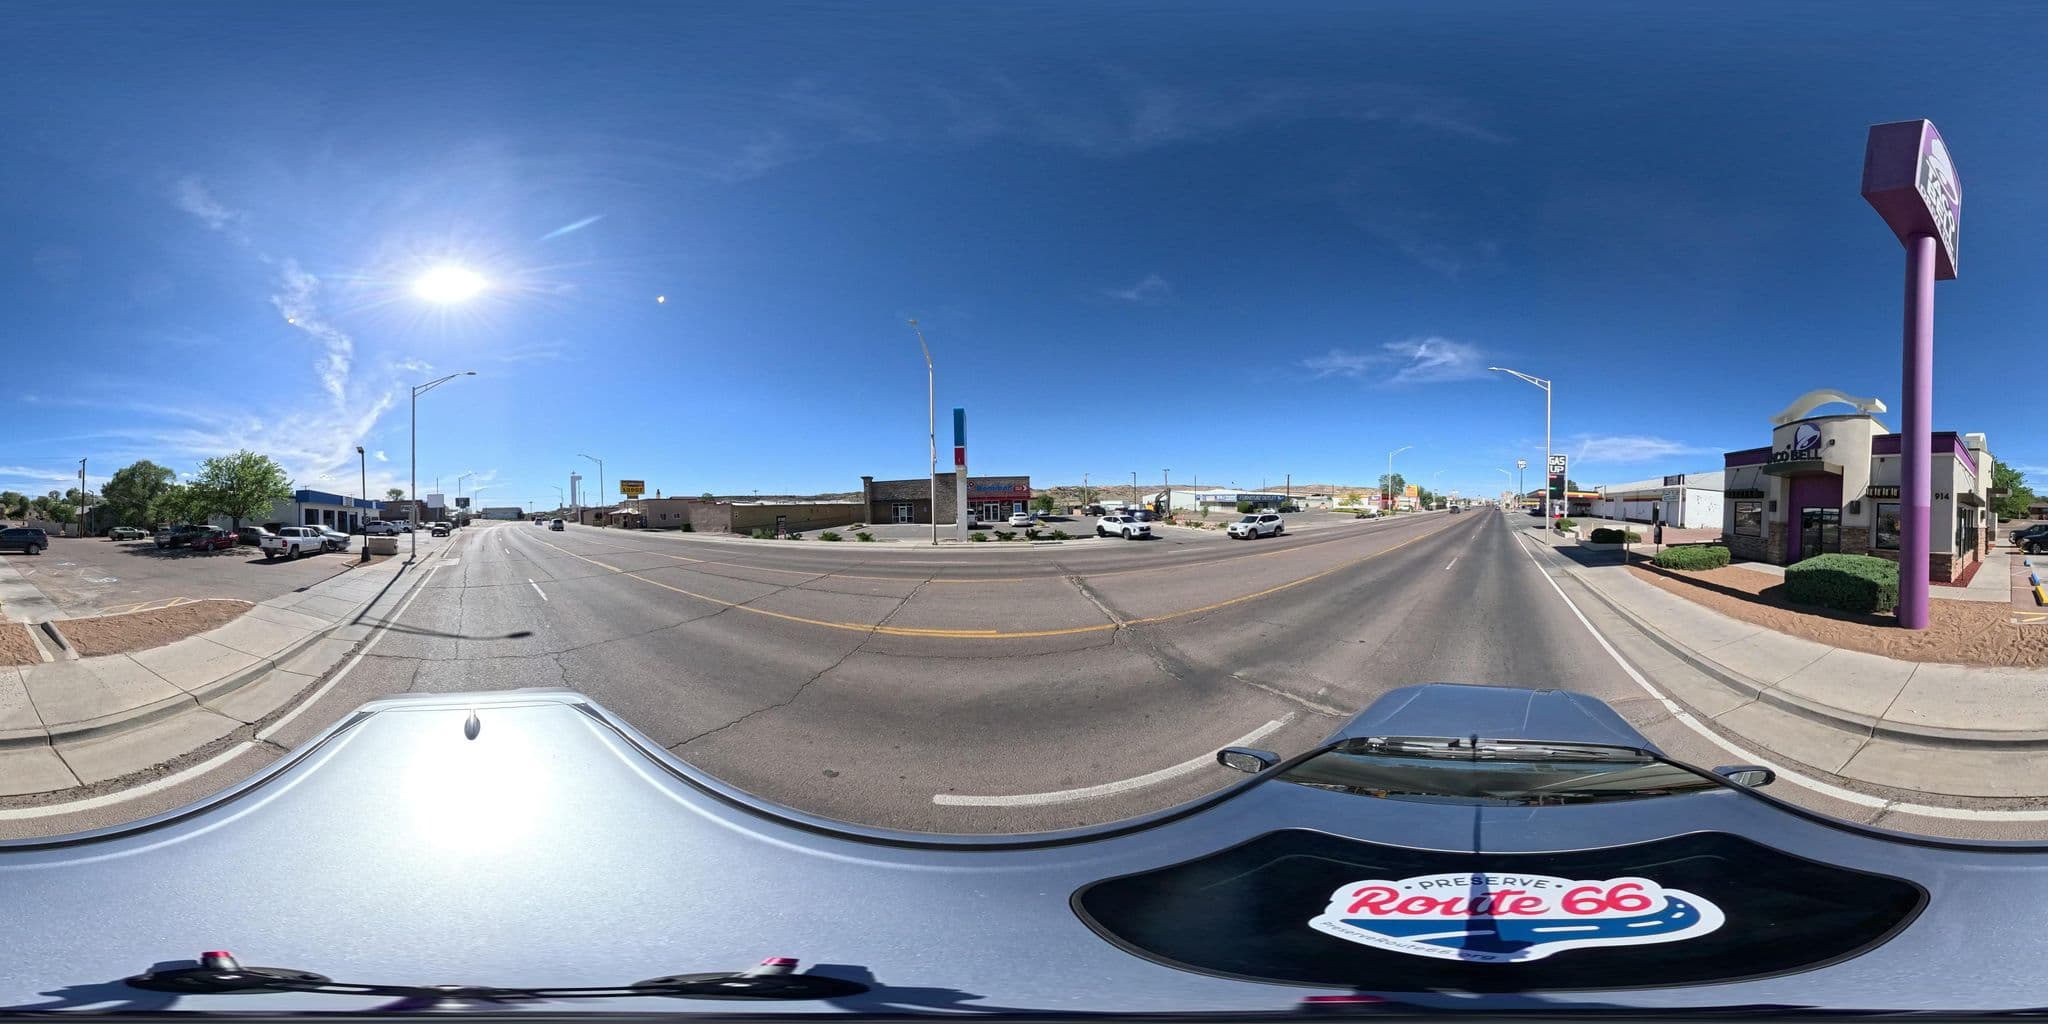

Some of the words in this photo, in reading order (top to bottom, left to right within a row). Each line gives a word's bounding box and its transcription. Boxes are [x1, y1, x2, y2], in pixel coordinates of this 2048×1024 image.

[1549, 456, 1565, 466] GAS
[1791, 449, 1822, 461] BELL
[1550, 465, 1564, 473] UP
[1419, 876, 1549, 890] PRESERVE
[1347, 886, 1549, 915] Route
[1562, 883, 1653, 915] 66
